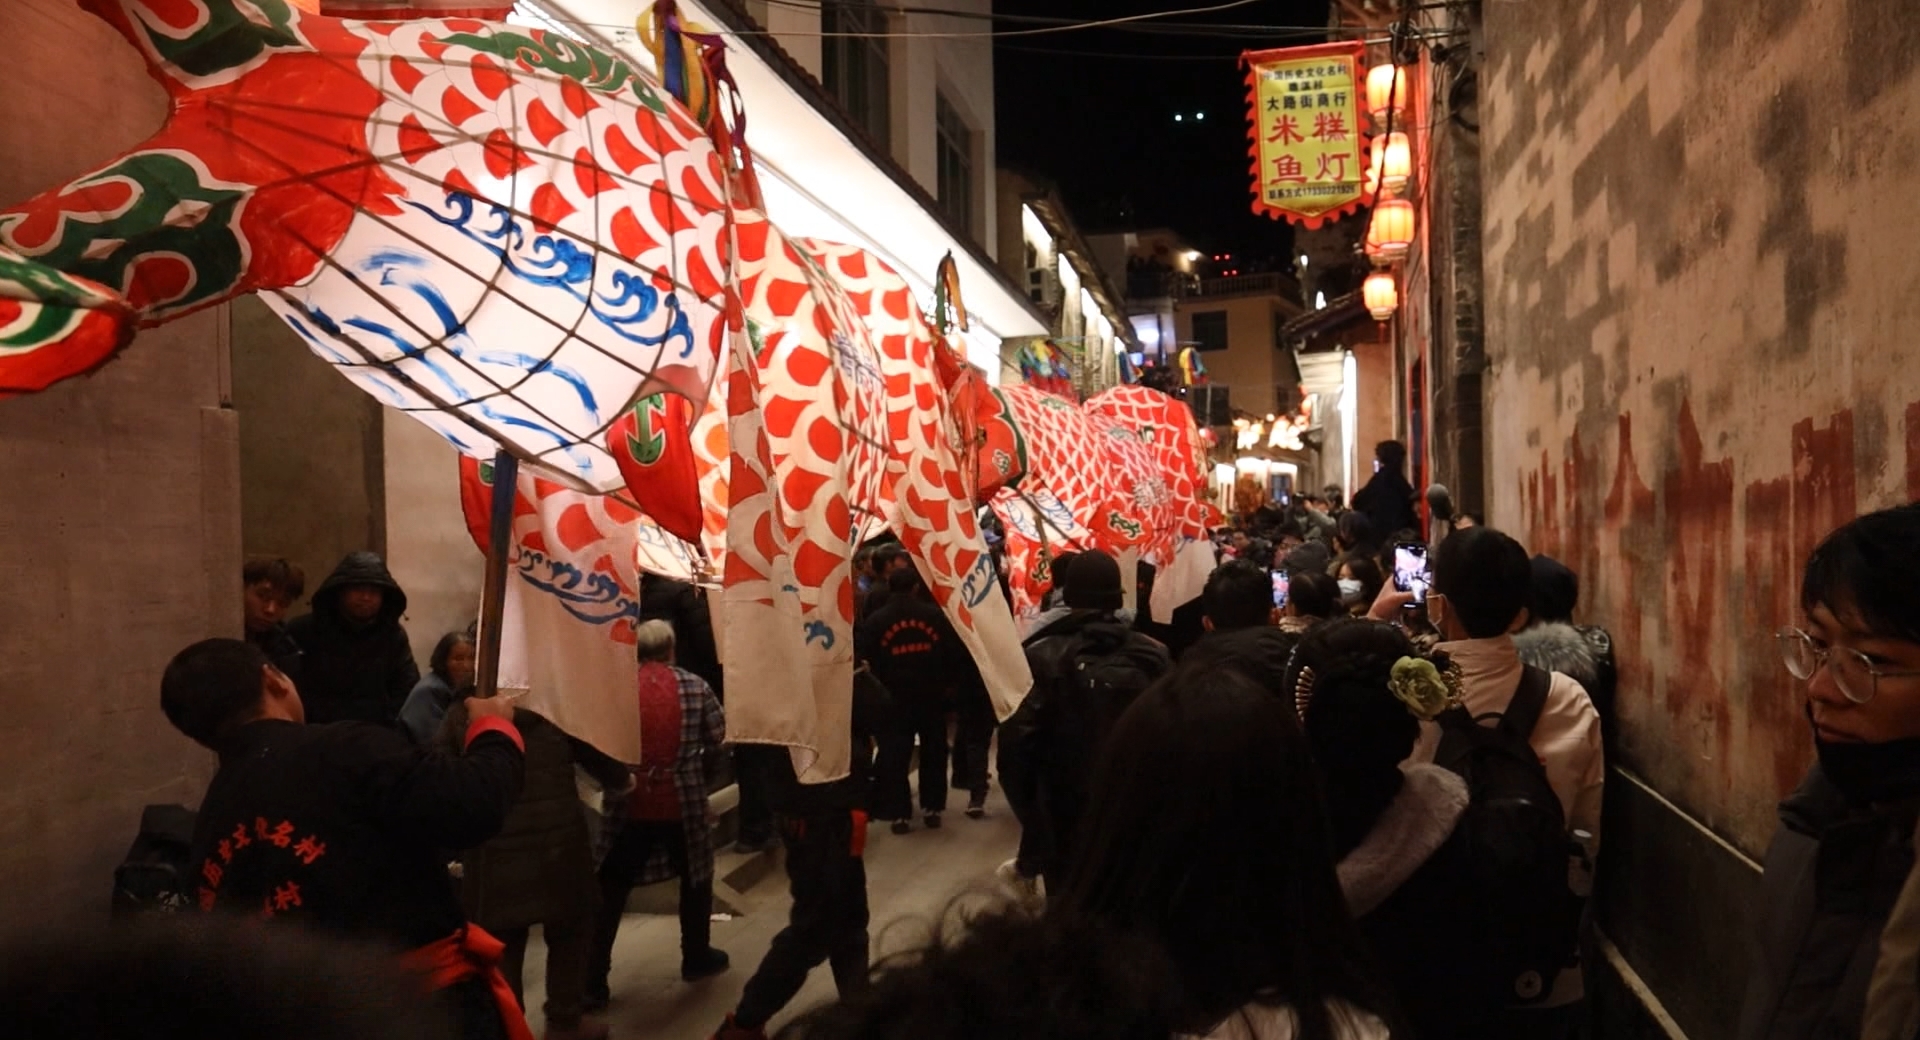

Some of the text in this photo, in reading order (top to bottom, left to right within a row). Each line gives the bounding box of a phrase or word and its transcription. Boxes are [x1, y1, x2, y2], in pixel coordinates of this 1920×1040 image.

[1267, 92, 1346, 111] 大路街商行
[1267, 111, 1350, 146] 米糕
[1270, 152, 1351, 185] 鱼灯
